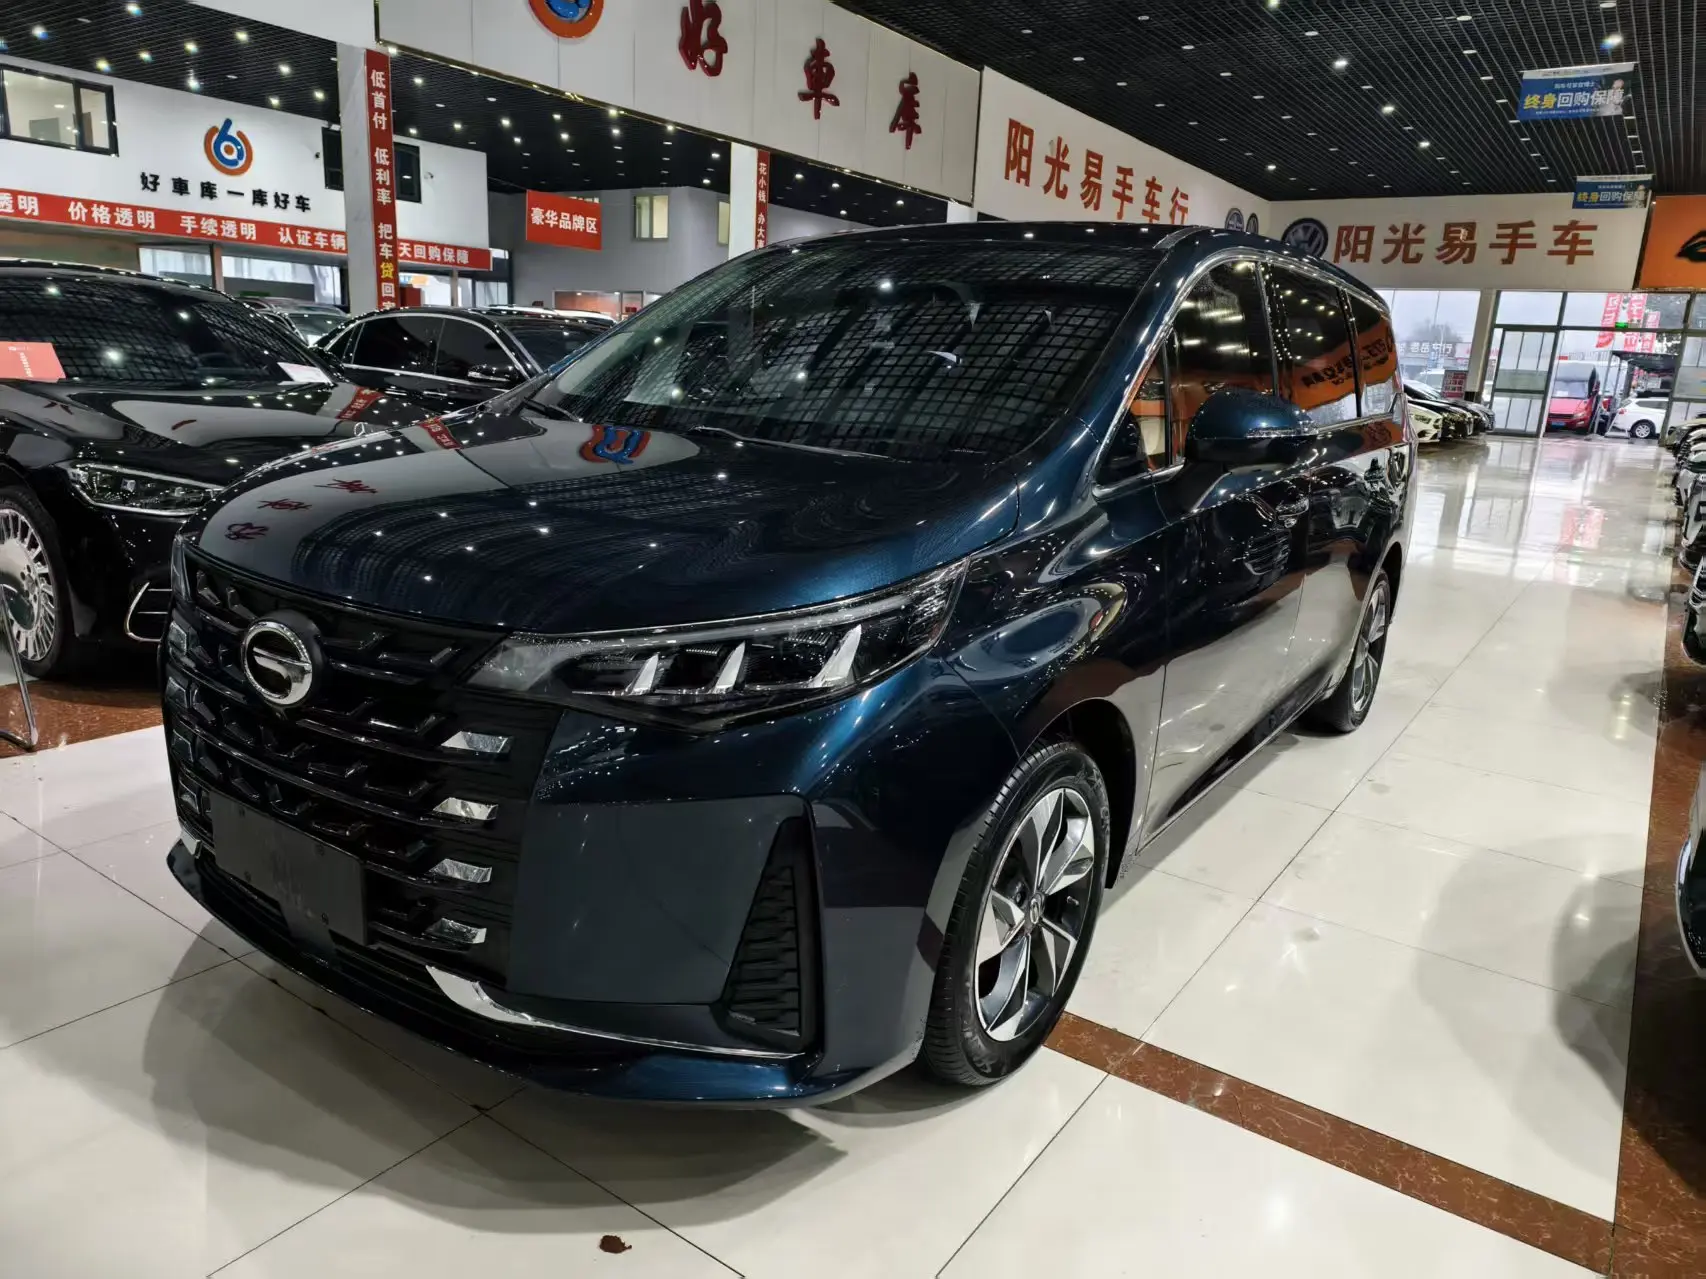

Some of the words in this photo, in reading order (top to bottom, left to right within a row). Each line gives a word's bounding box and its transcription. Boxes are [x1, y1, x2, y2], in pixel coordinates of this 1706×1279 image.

[370, 69, 388, 130] 低首付
[374, 147, 392, 205] 低利率
[1004, 117, 1190, 225] 阳光易手车行
[68, 200, 156, 230] 价格透明
[180, 215, 257, 241] 手续透明
[278, 227, 347, 250] 认证车辆
[531, 207, 598, 234] 豪华品牌区
[1332, 219, 1599, 265] 阳光易手车
